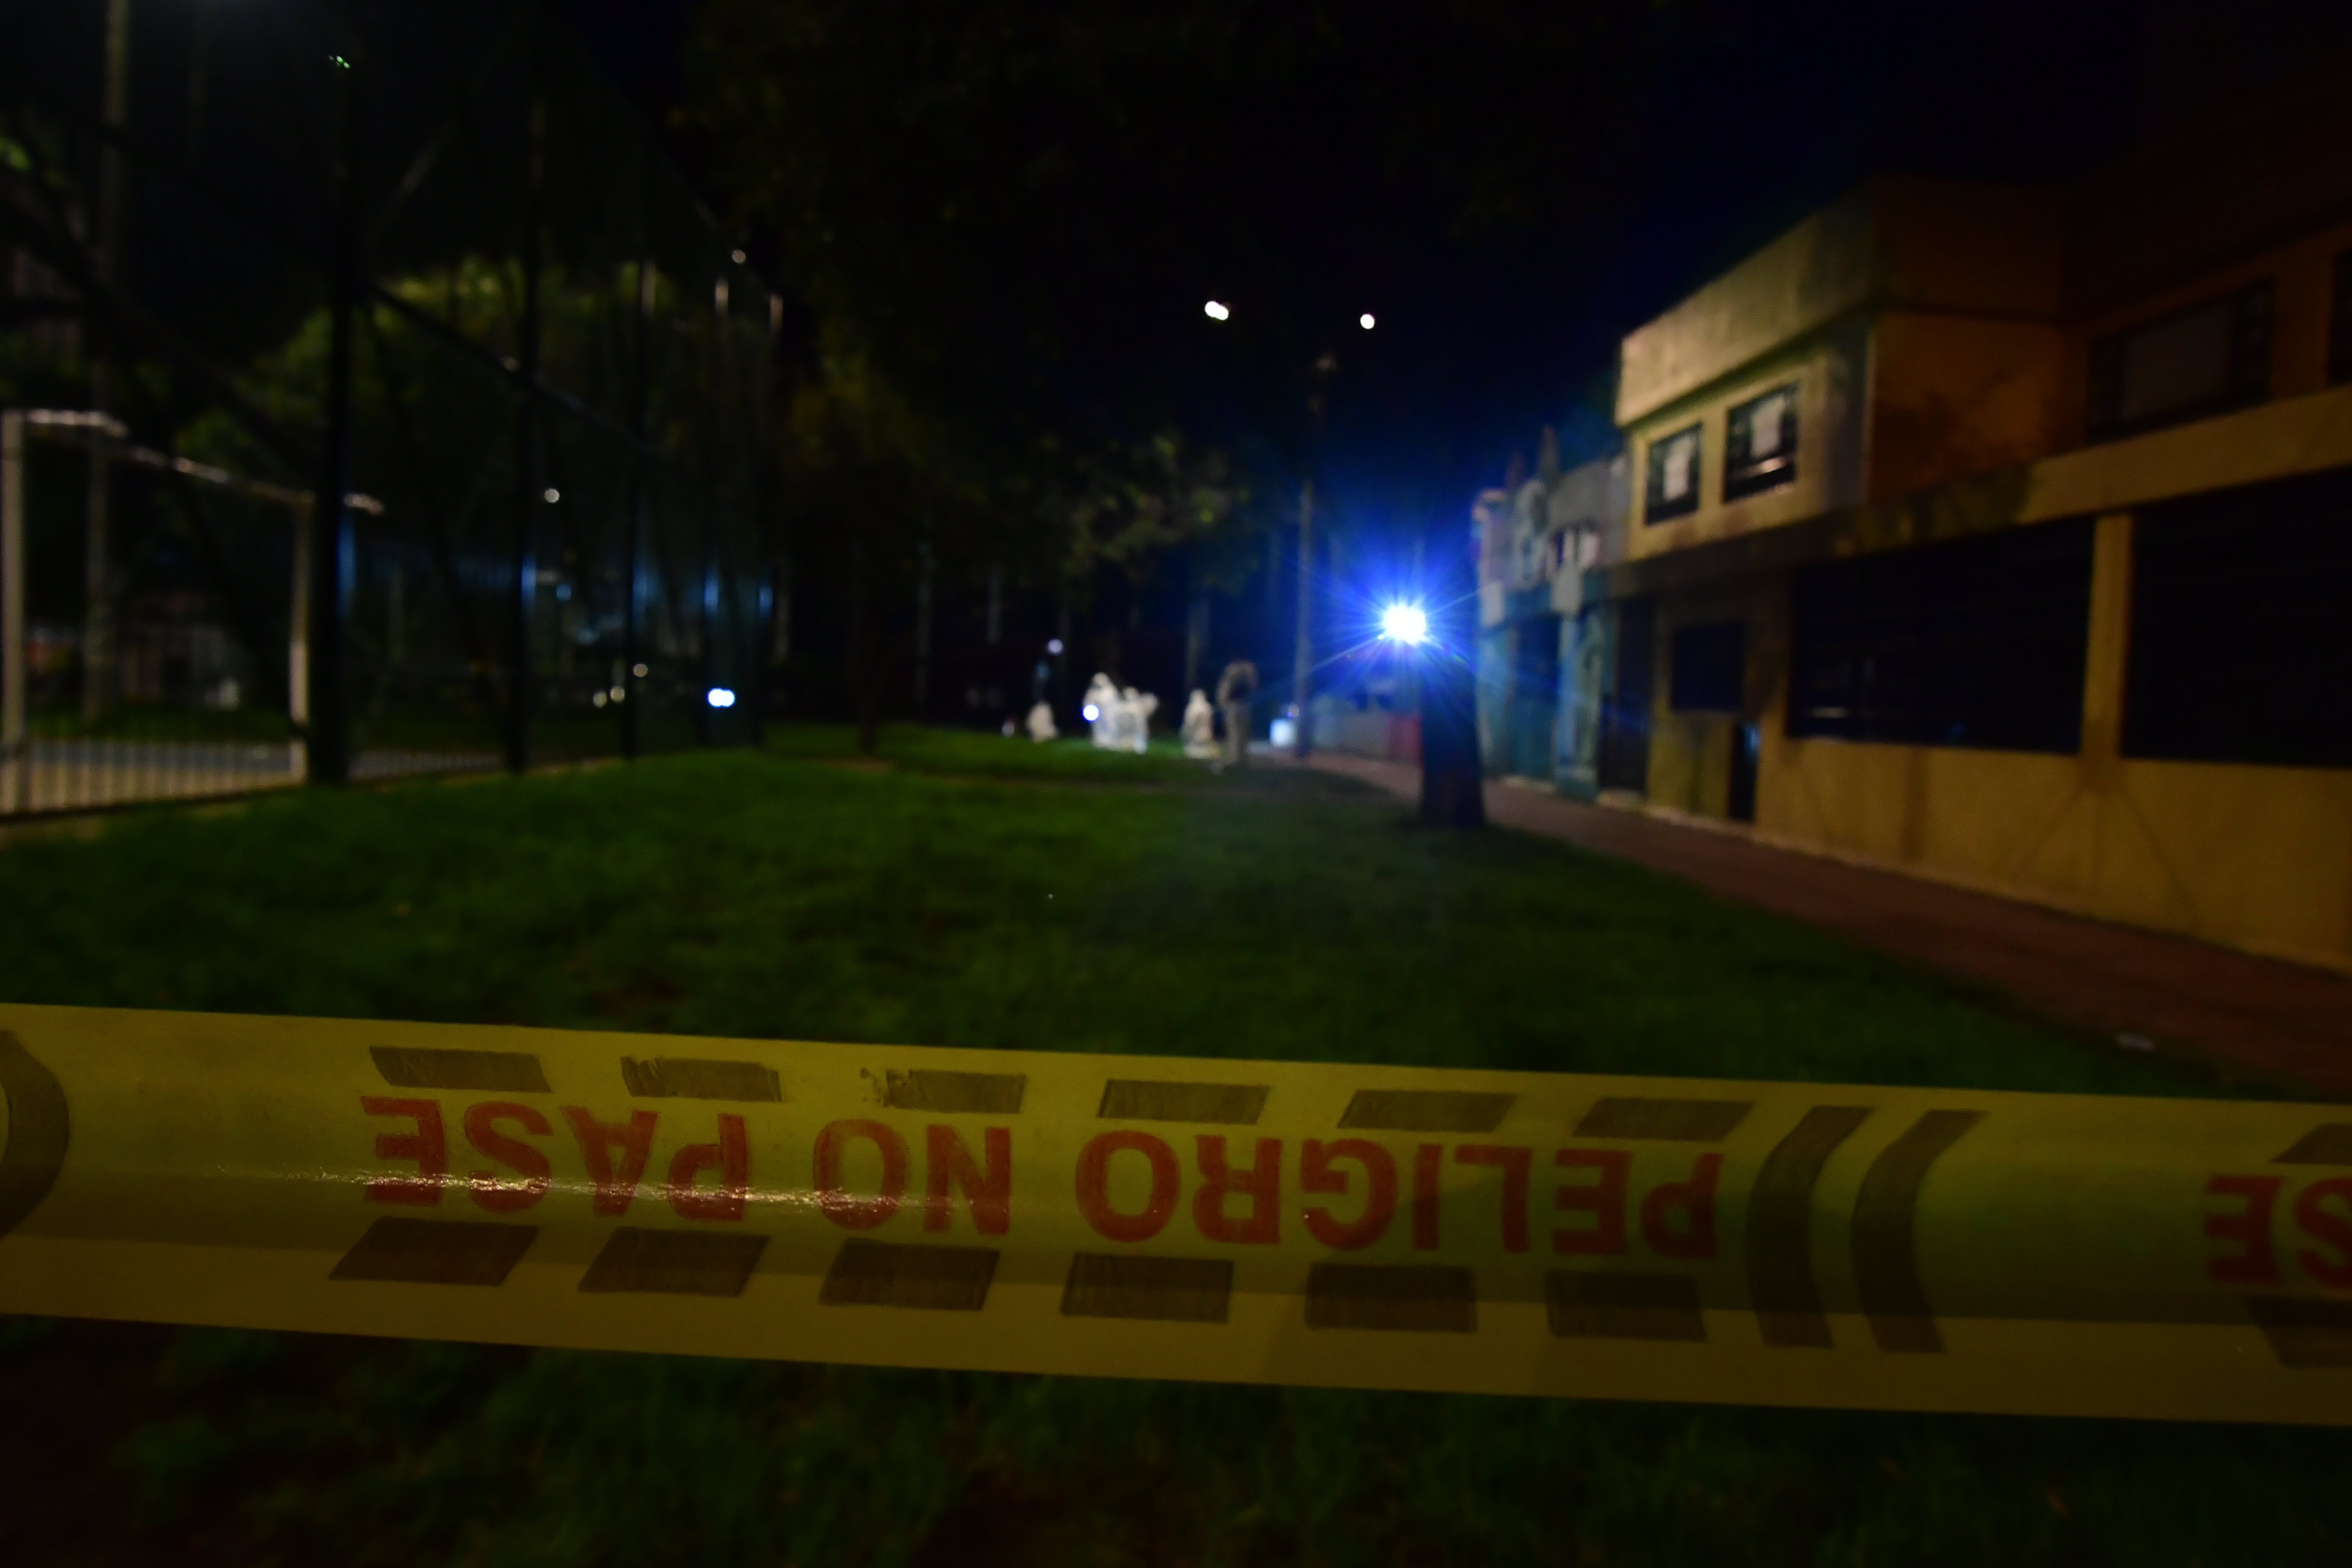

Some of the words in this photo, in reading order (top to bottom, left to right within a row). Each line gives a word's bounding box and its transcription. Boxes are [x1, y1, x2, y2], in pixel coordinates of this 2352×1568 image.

[361, 1095, 749, 1222] PASE
[812, 1118, 1011, 1236] NO
[1075, 1130, 1725, 1258] PELIGRO
